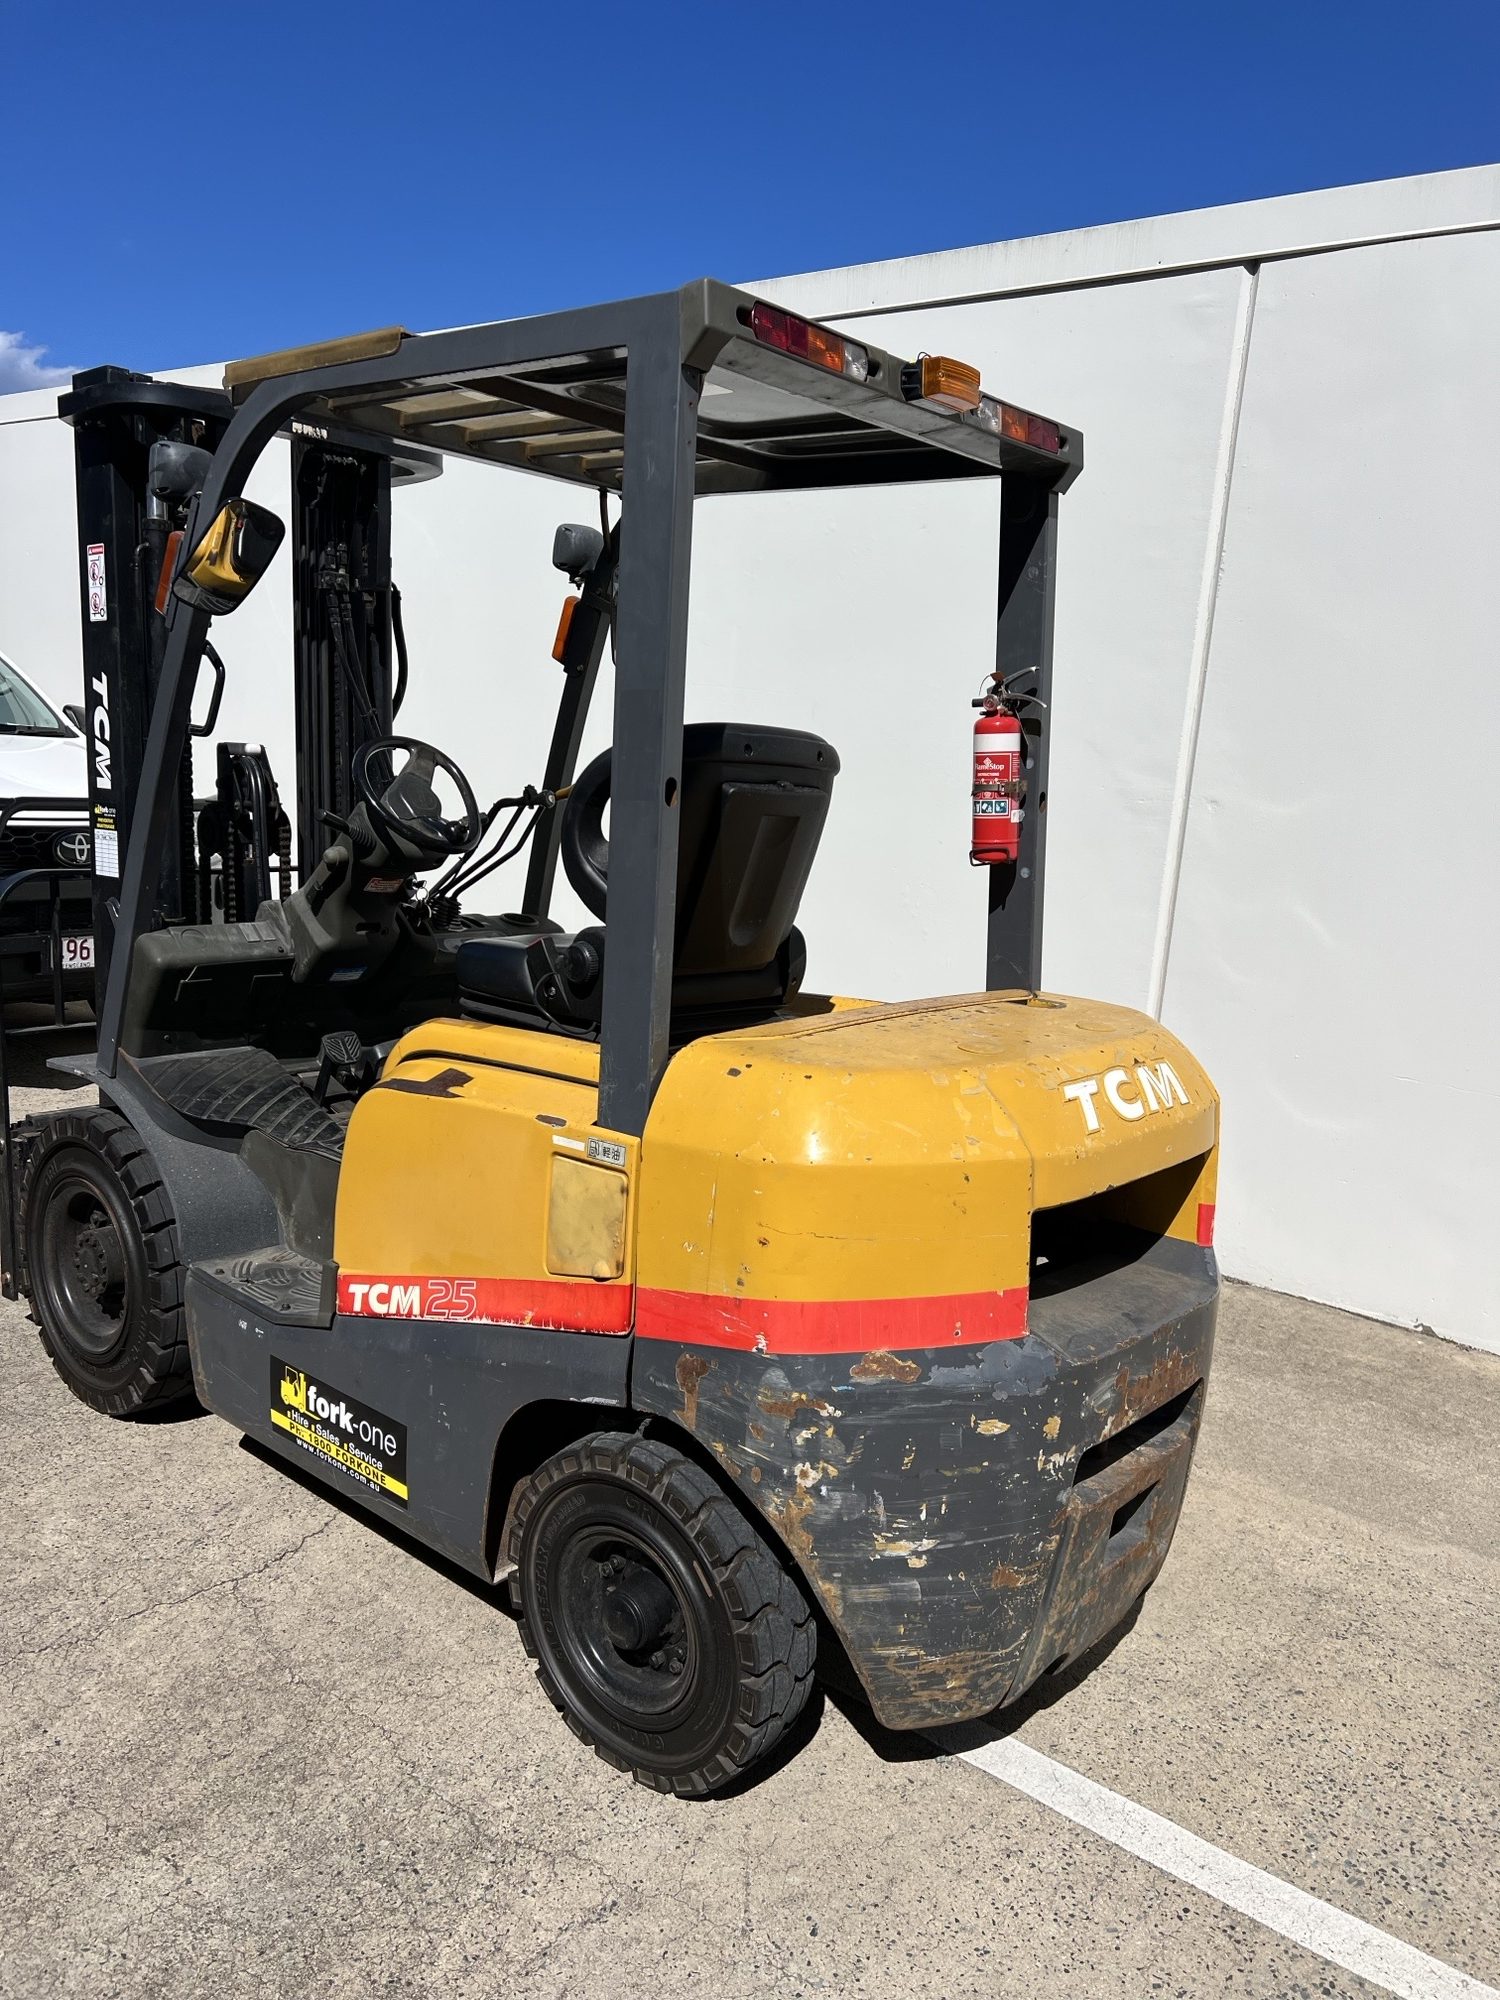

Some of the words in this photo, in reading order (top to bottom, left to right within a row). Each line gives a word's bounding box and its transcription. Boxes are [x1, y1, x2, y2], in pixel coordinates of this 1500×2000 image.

[92, 671, 112, 790] TCM
[66, 937, 91, 962] 96
[1063, 1062, 1191, 1132] TCM
[348, 1283, 421, 1316] TCM
[424, 1279, 477, 1319] 25
[296, 1437, 381, 1493] www.forkone.com.au
[308, 1432, 332, 1453] 1800
[335, 1448, 387, 1486] FORKONE
[315, 1423, 340, 1446] Sales
[348, 1441, 383, 1471] Service
